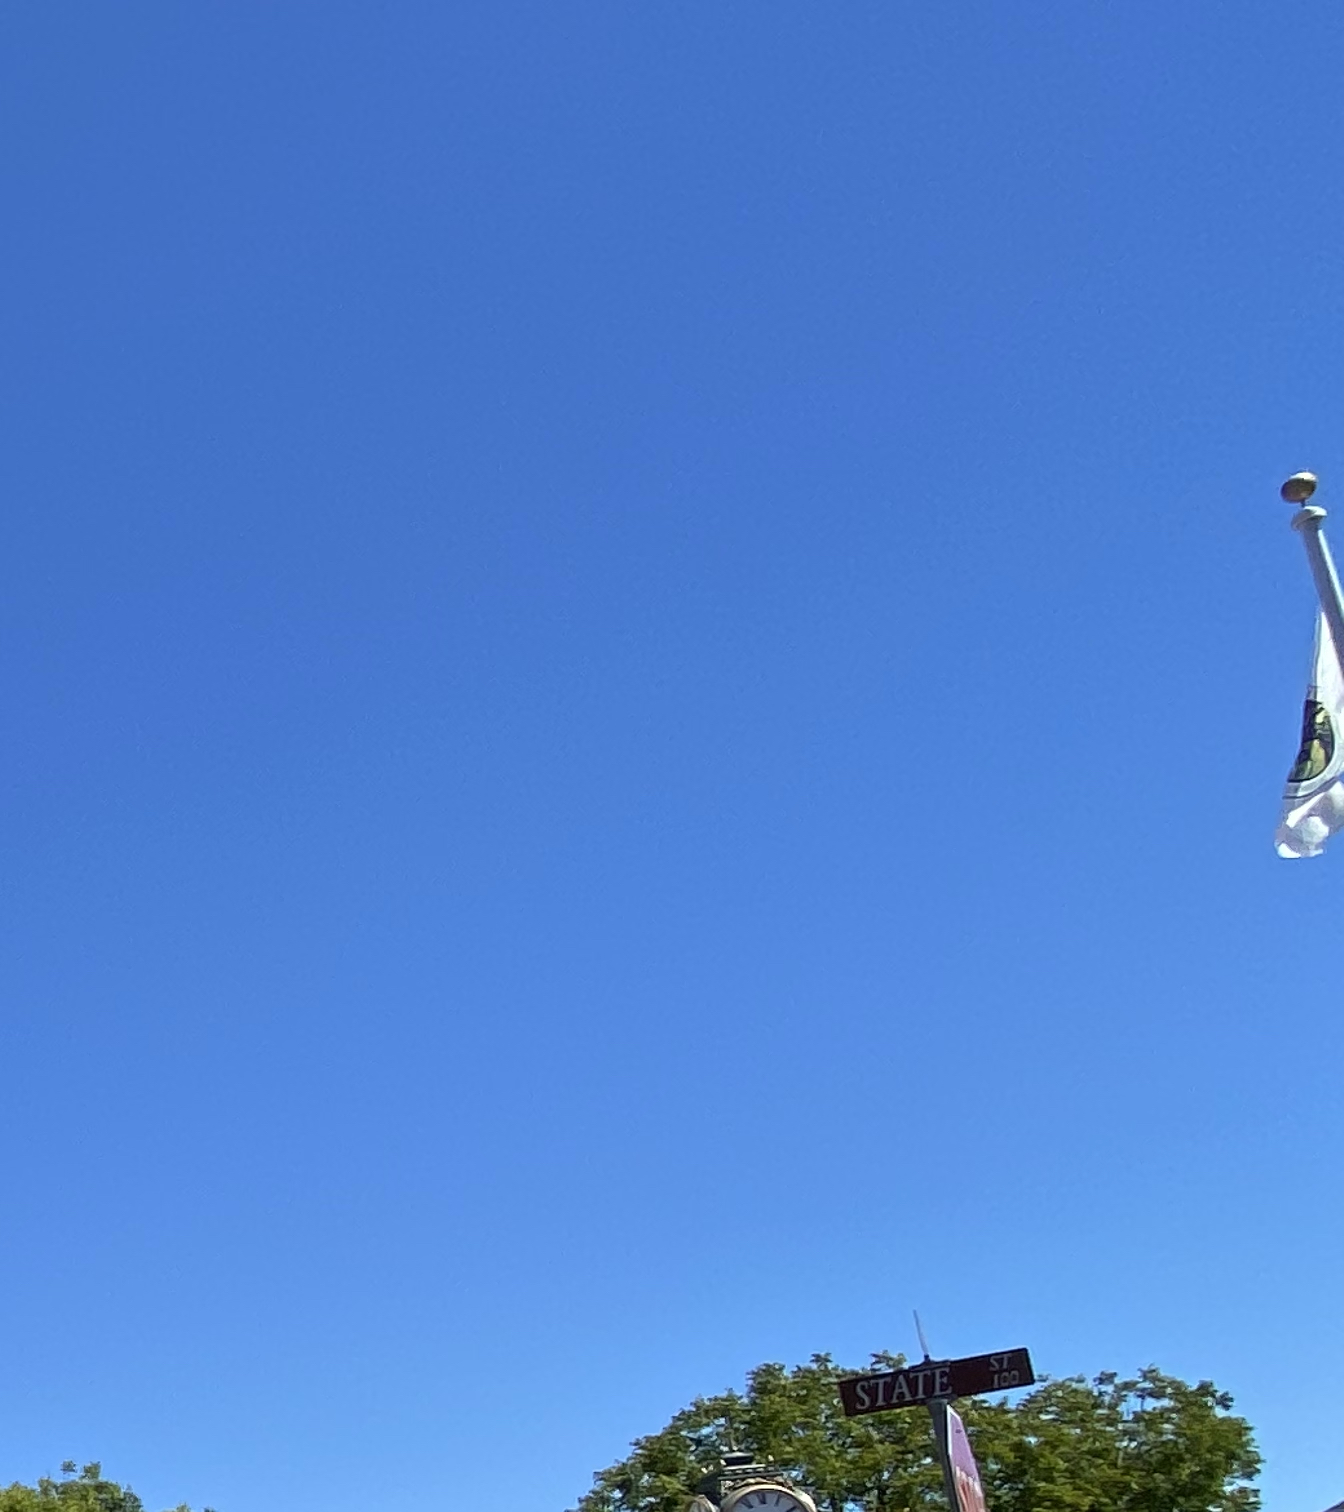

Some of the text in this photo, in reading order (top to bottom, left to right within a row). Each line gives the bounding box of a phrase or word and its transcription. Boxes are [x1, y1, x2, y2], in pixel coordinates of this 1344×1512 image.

[989, 1353, 1013, 1372] ST
[854, 1367, 953, 1411] STATE
[992, 1369, 1020, 1389] 100
